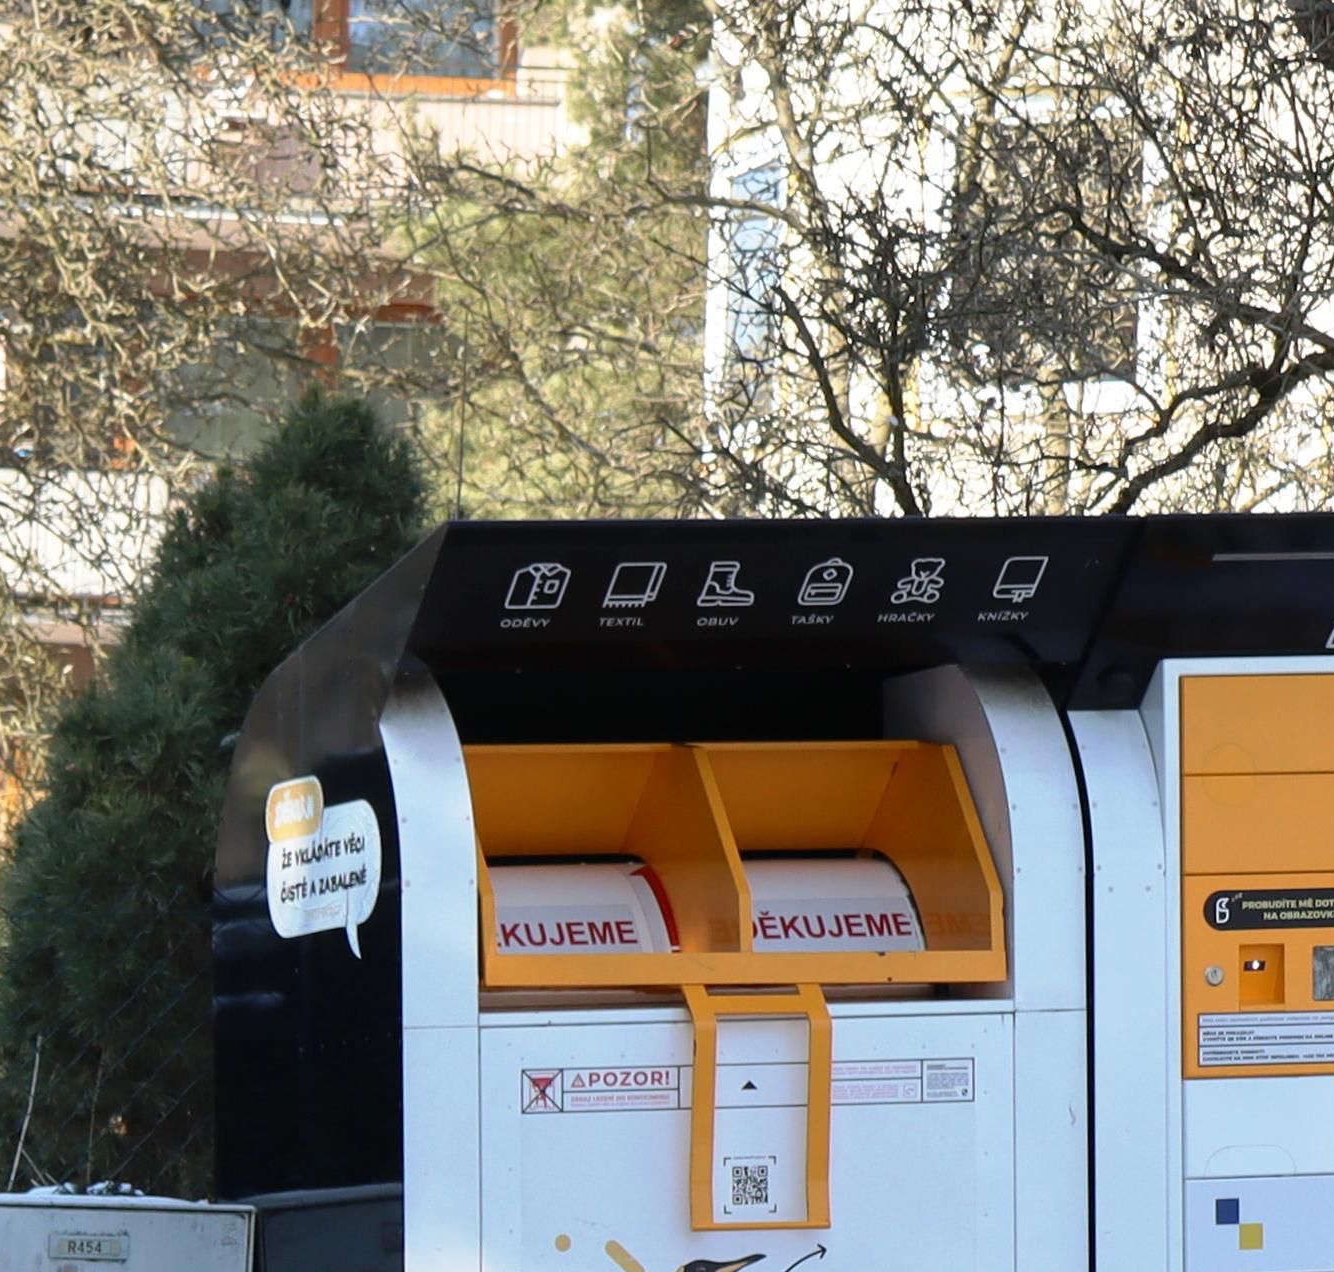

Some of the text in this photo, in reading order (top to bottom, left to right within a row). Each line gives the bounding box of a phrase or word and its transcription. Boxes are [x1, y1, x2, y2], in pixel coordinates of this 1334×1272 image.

[500, 617, 551, 628] ODĚVY
[599, 617, 644, 627] TEXTIL
[696, 617, 739, 627] OBUV
[791, 612, 835, 625] TAŠKY
[877, 612, 936, 623] HRAČKY
[977, 611, 1029, 622] KNÍŽKY
[281, 831, 365, 870] ŽE VKLÁDÁTE VĚCI
[280, 864, 367, 903] ČISTÉ A ZABALENÉ
[1242, 899, 1297, 910] PROBUDÍTE
[1298, 898, 1313, 908] MĚ
[1263, 912, 1279, 920] NA
[752, 910, 913, 941] ĚKUJEME
[588, 1070, 671, 1087] POZOR!
[68, 1240, 101, 1254] R454
